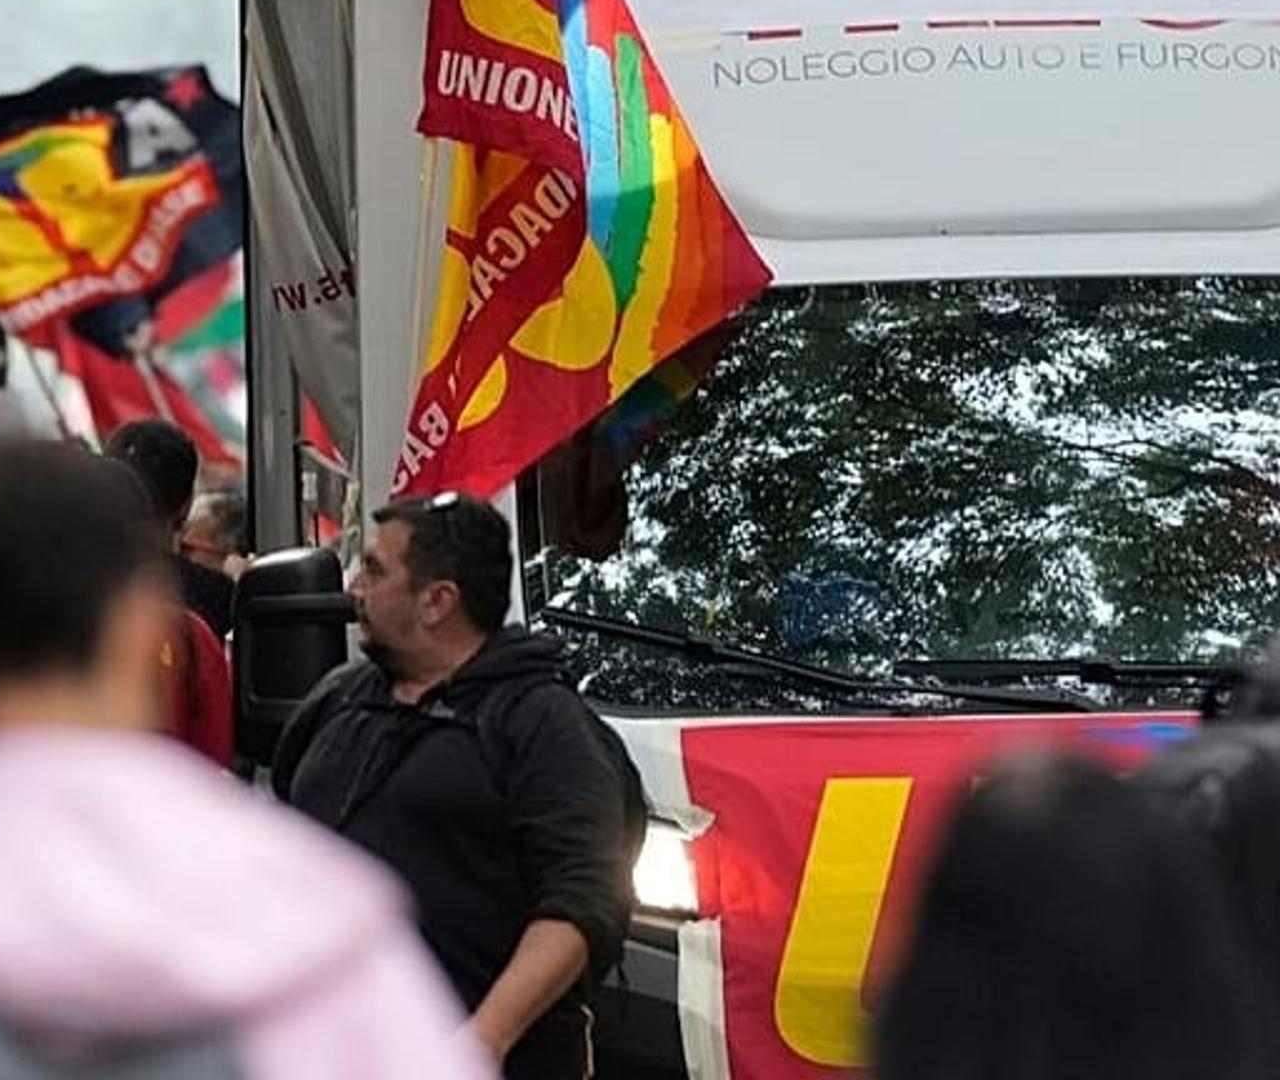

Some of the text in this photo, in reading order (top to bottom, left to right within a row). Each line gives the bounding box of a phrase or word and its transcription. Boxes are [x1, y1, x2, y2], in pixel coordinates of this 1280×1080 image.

[712, 45, 937, 88] NOLEGGIO
[946, 40, 1065, 72] AUTO
[1079, 41, 1103, 70] E
